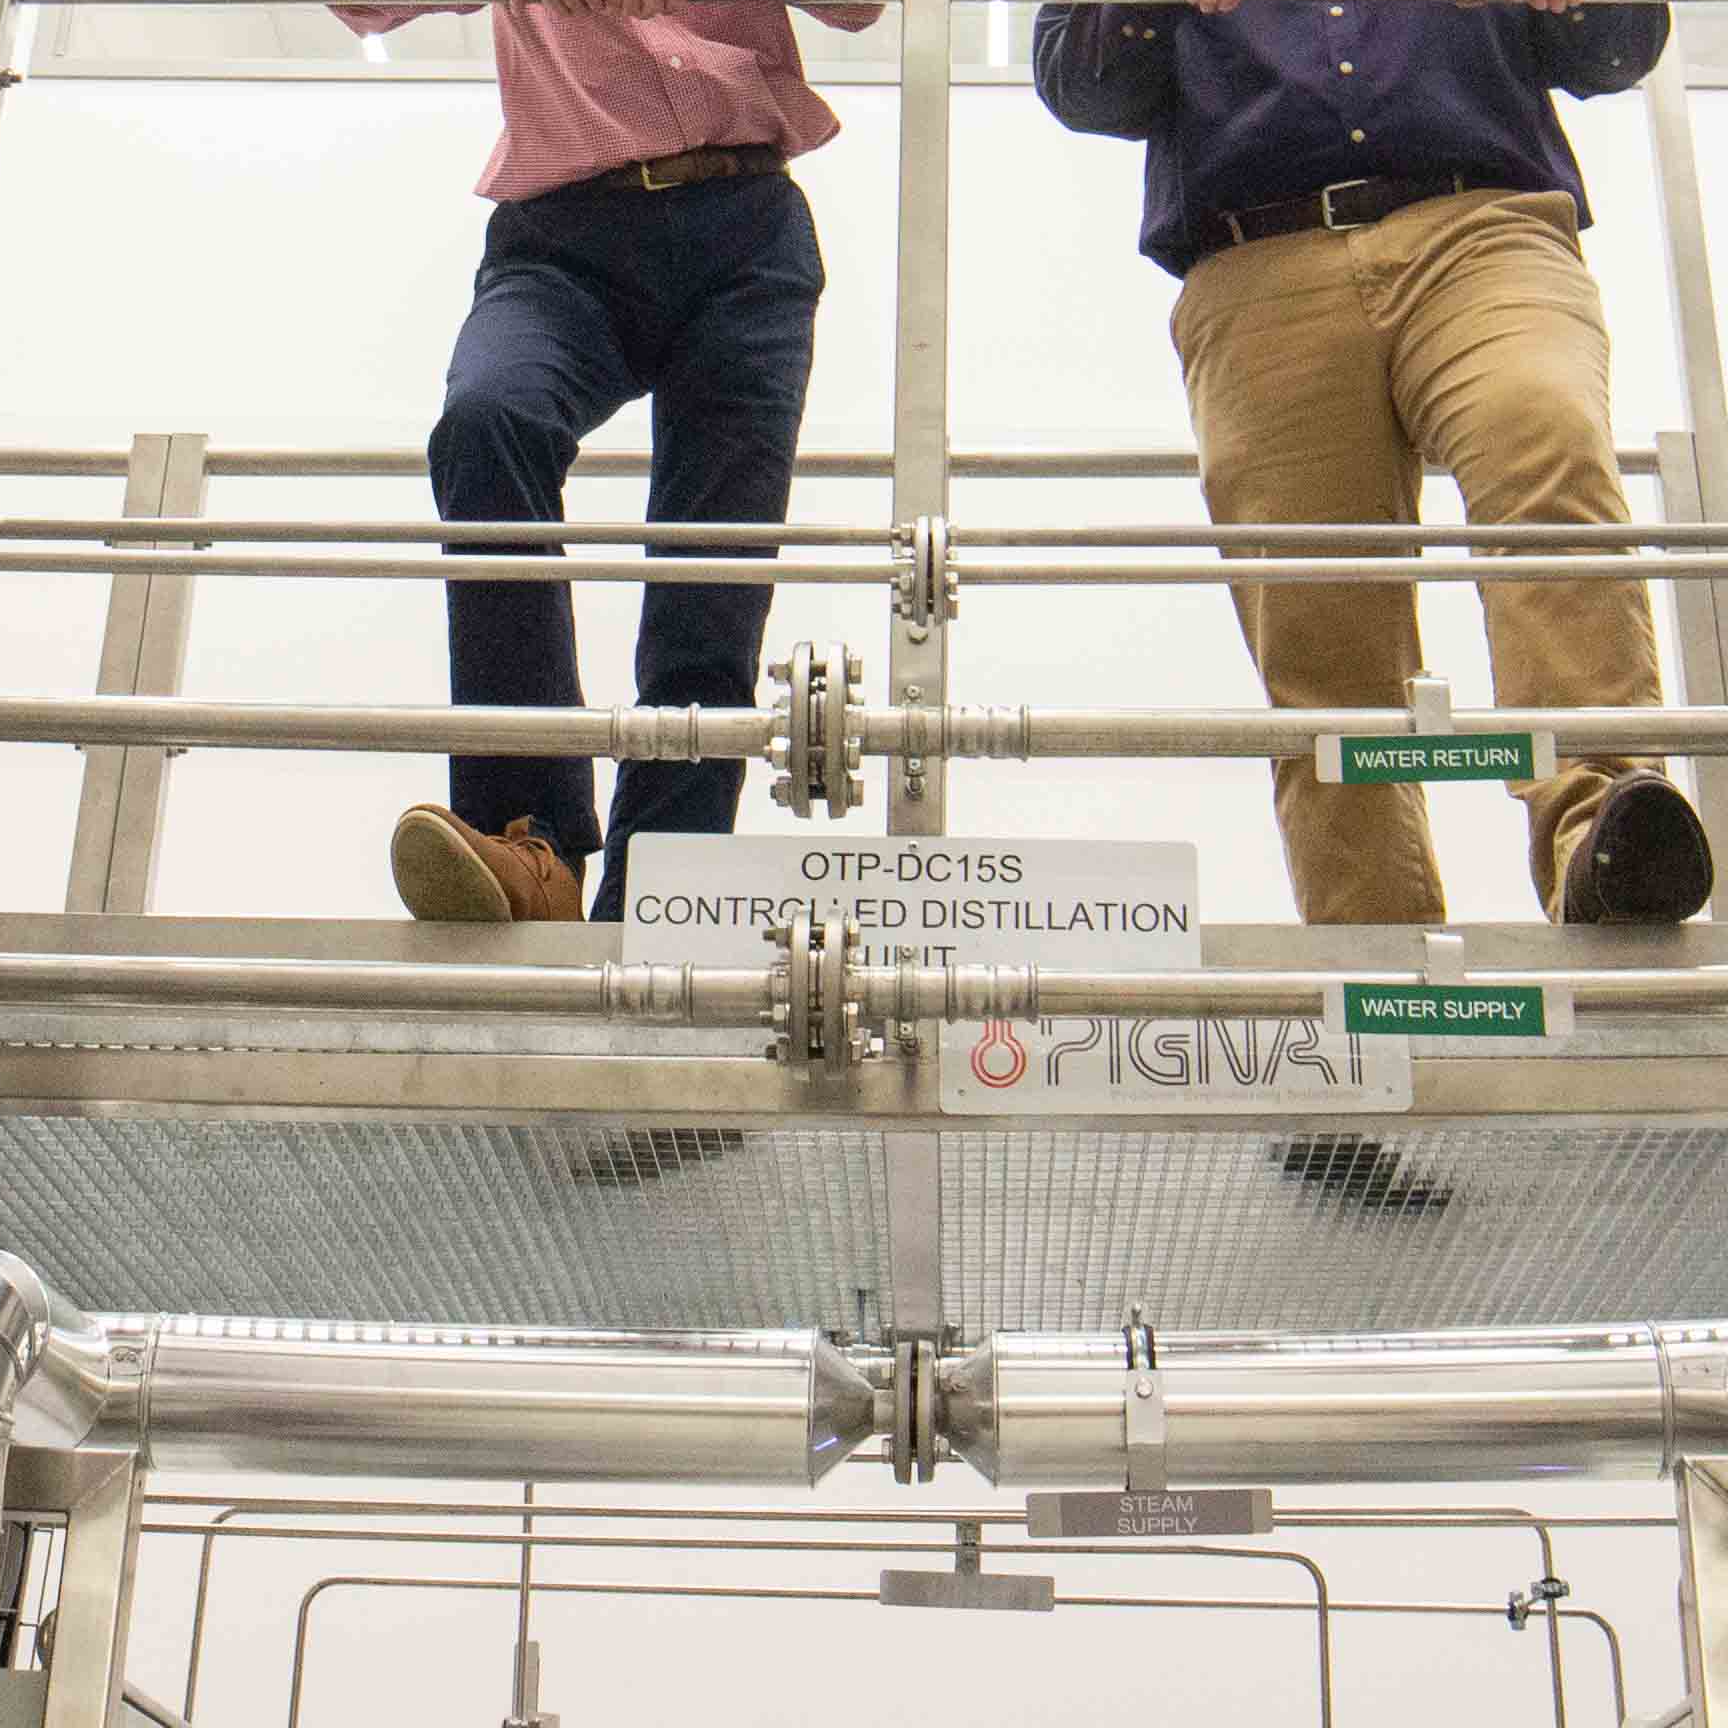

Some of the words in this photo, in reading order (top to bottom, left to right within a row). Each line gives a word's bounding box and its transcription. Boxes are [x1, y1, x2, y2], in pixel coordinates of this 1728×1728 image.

[1354, 750, 1427, 769] WATER
[1433, 748, 1521, 768] RETURN
[801, 852, 1024, 883] OTP-DC15S
[635, 896, 907, 929] CONTROLED
[921, 899, 1189, 934] DISTILLATION
[1361, 998, 1438, 1018] WATER
[1443, 1001, 1526, 1020] SUPPLY
[1119, 1495, 1194, 1513] STEAM
[1116, 1517, 1199, 1536] SUPPLY
